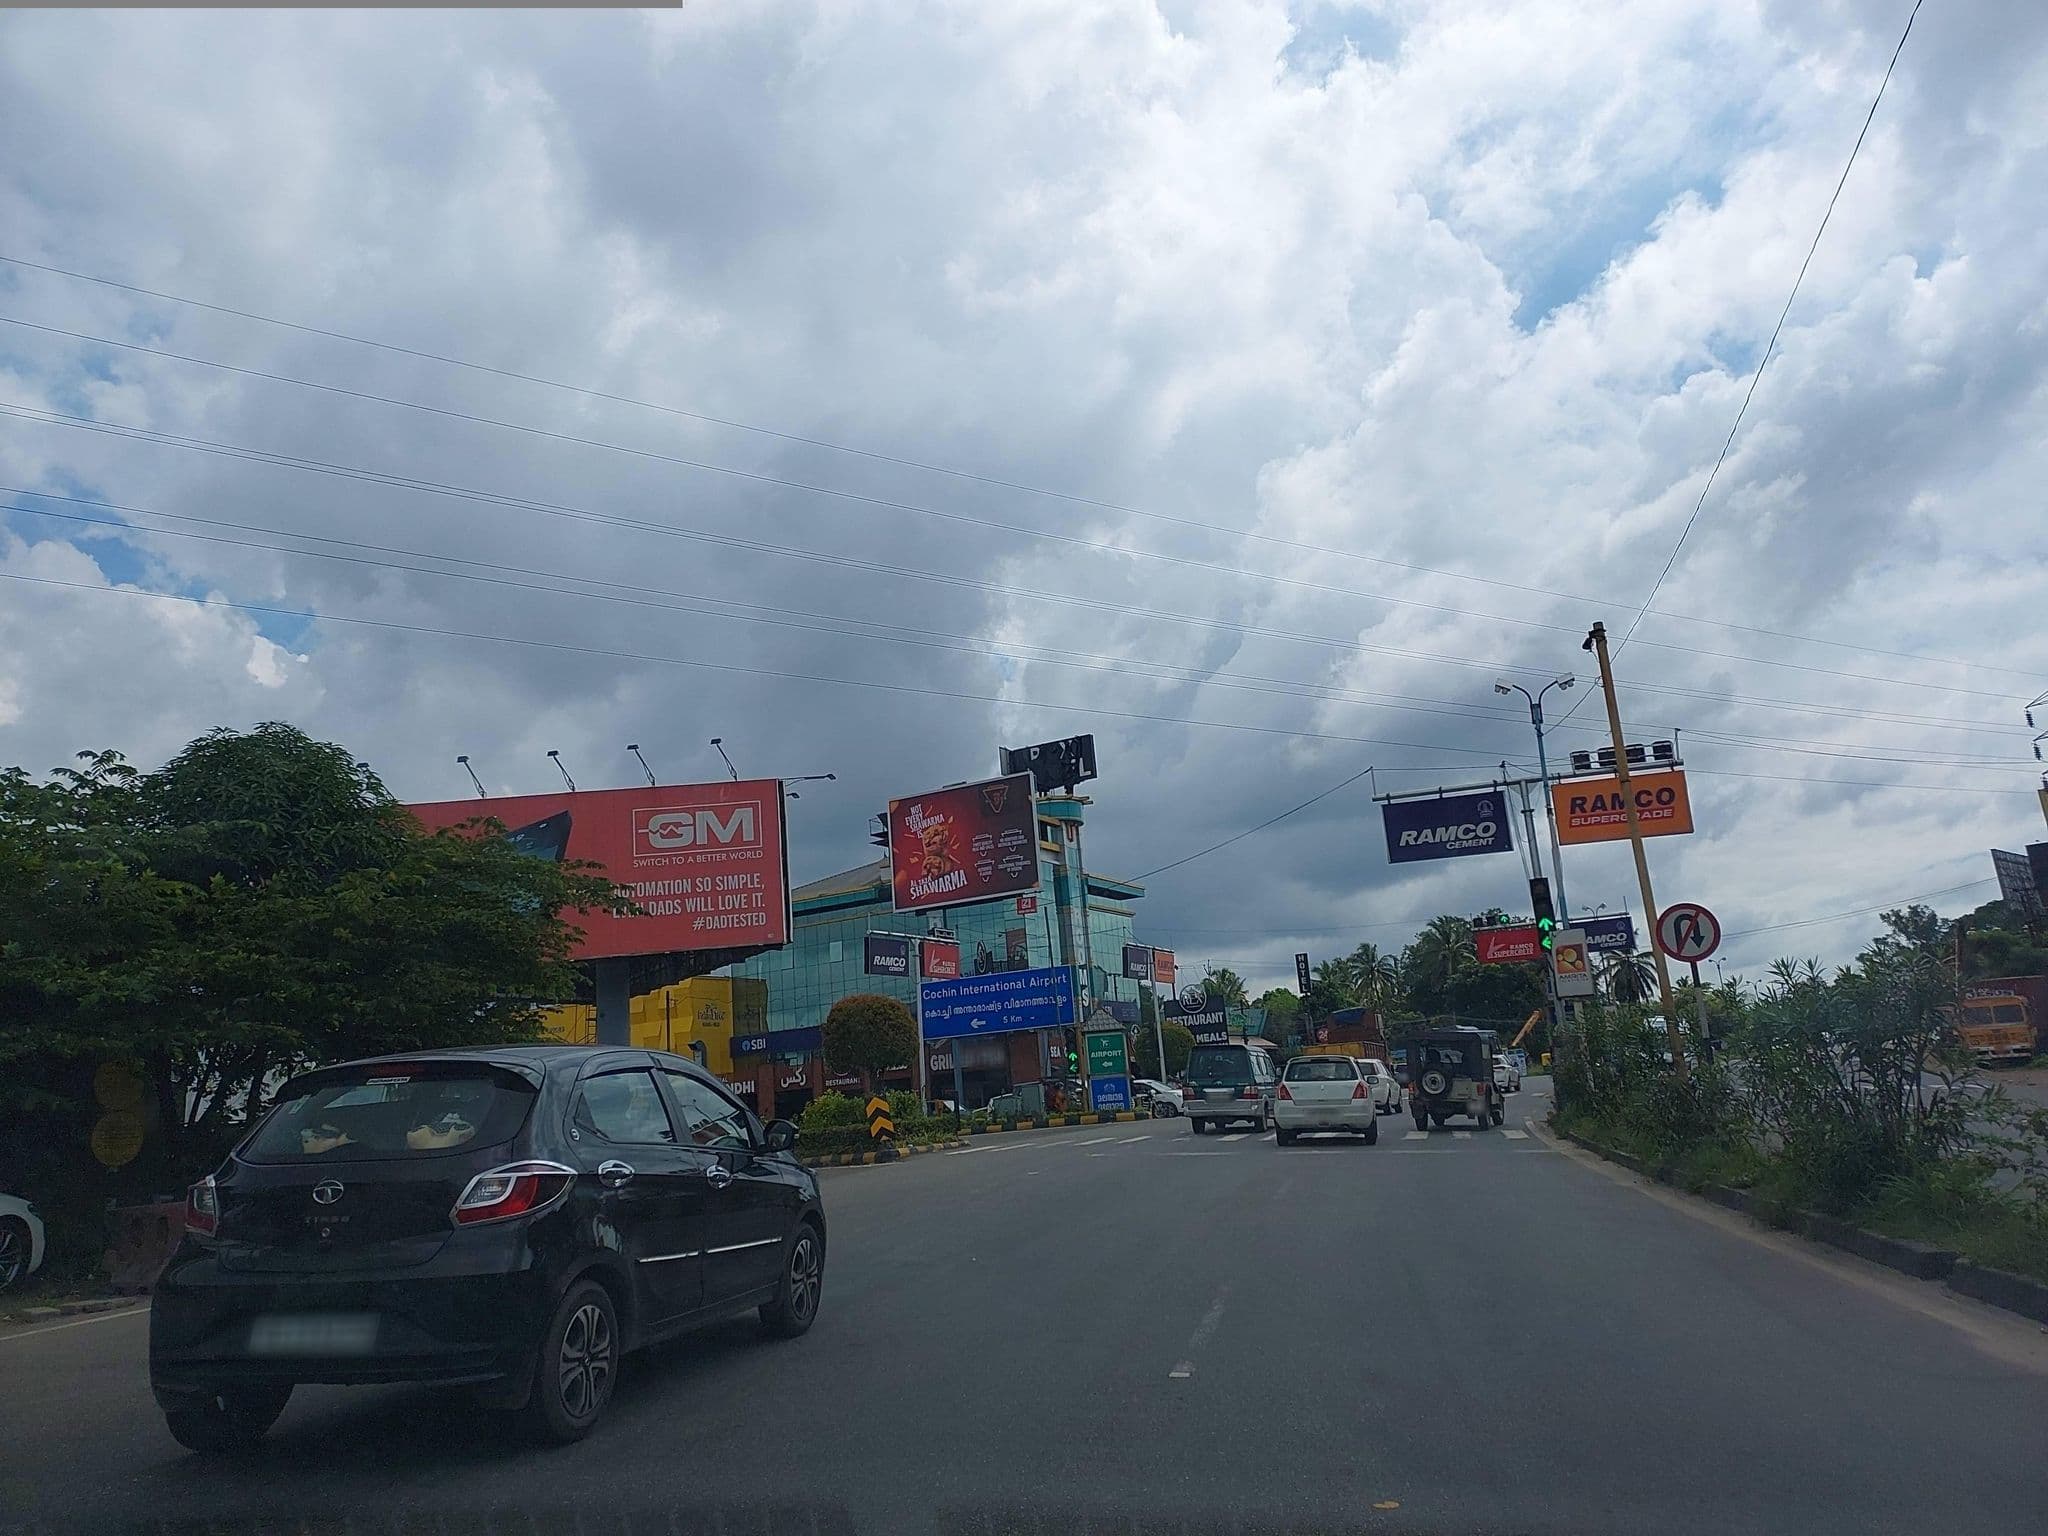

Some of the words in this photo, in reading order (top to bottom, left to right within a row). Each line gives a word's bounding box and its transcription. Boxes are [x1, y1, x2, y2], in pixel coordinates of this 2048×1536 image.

[1569, 787, 1675, 815] RAMCO
[1571, 808, 1673, 826] SUPERGADE
[648, 807, 755, 849] GM
[1399, 821, 1497, 847] RAMCO
[1446, 837, 1495, 850] CEMENT
[634, 855, 669, 868] SWITCH
[672, 856, 684, 865] TO
[686, 856, 695, 864] A
[696, 853, 727, 863] BETTER
[730, 851, 764, 860] WORLD
[695, 876, 712, 893] SO
[715, 873, 765, 891] SIMPLE,
[909, 869, 968, 900] SHAWARMA
[650, 899, 682, 916] DADS
[685, 897, 715, 913] WILL
[718, 894, 748, 911] LOVE
[752, 892, 766, 908] IT.
[692, 912, 767, 932] #DADTESTED
[1586, 932, 1628, 944] AMCO
[873, 955, 906, 967] RAMCO
[1297, 954, 1307, 992] HOTEL
[922, 987, 958, 1000] Cochin
[959, 978, 1026, 996] International
[1010, 1015, 1023, 1023] Km
[751, 1038, 766, 1051] SBI
[1196, 1031, 1228, 1044] MEALS
[1090, 1049, 1122, 1059] AIRPORT
